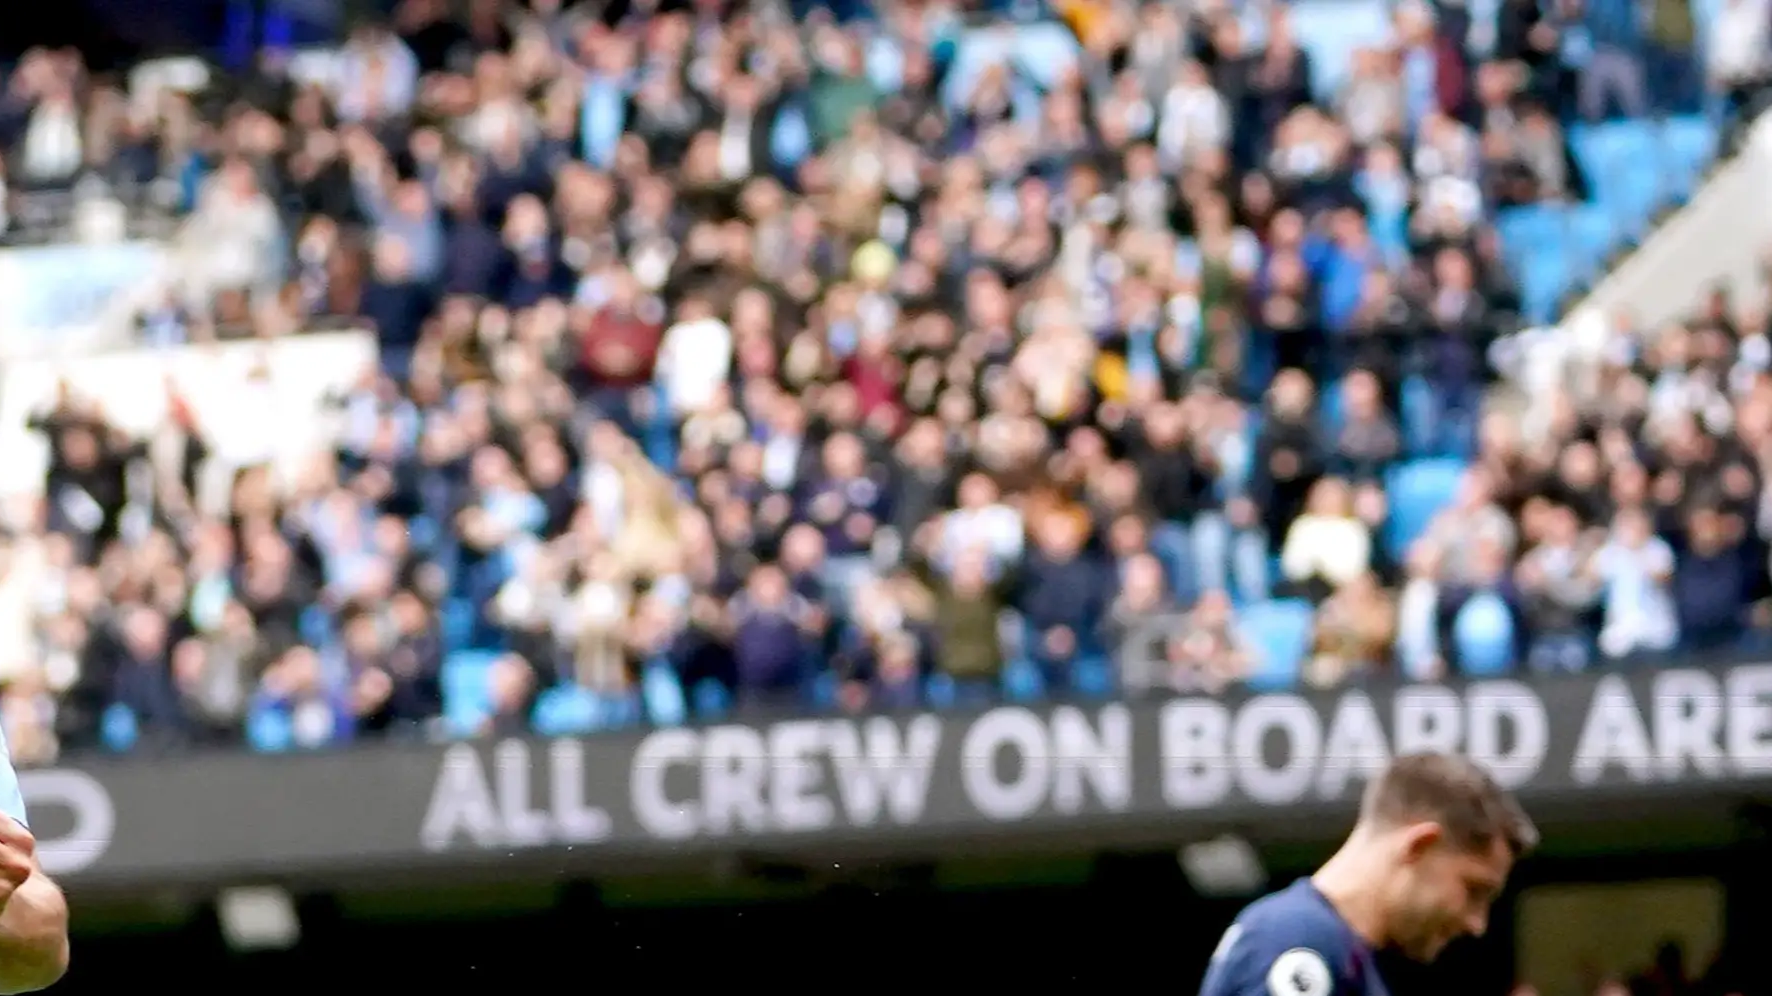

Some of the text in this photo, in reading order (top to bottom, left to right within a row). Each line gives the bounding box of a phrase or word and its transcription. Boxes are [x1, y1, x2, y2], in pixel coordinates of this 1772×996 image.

[420, 664, 1772, 852] ALL CREW ON BOARD ARE
